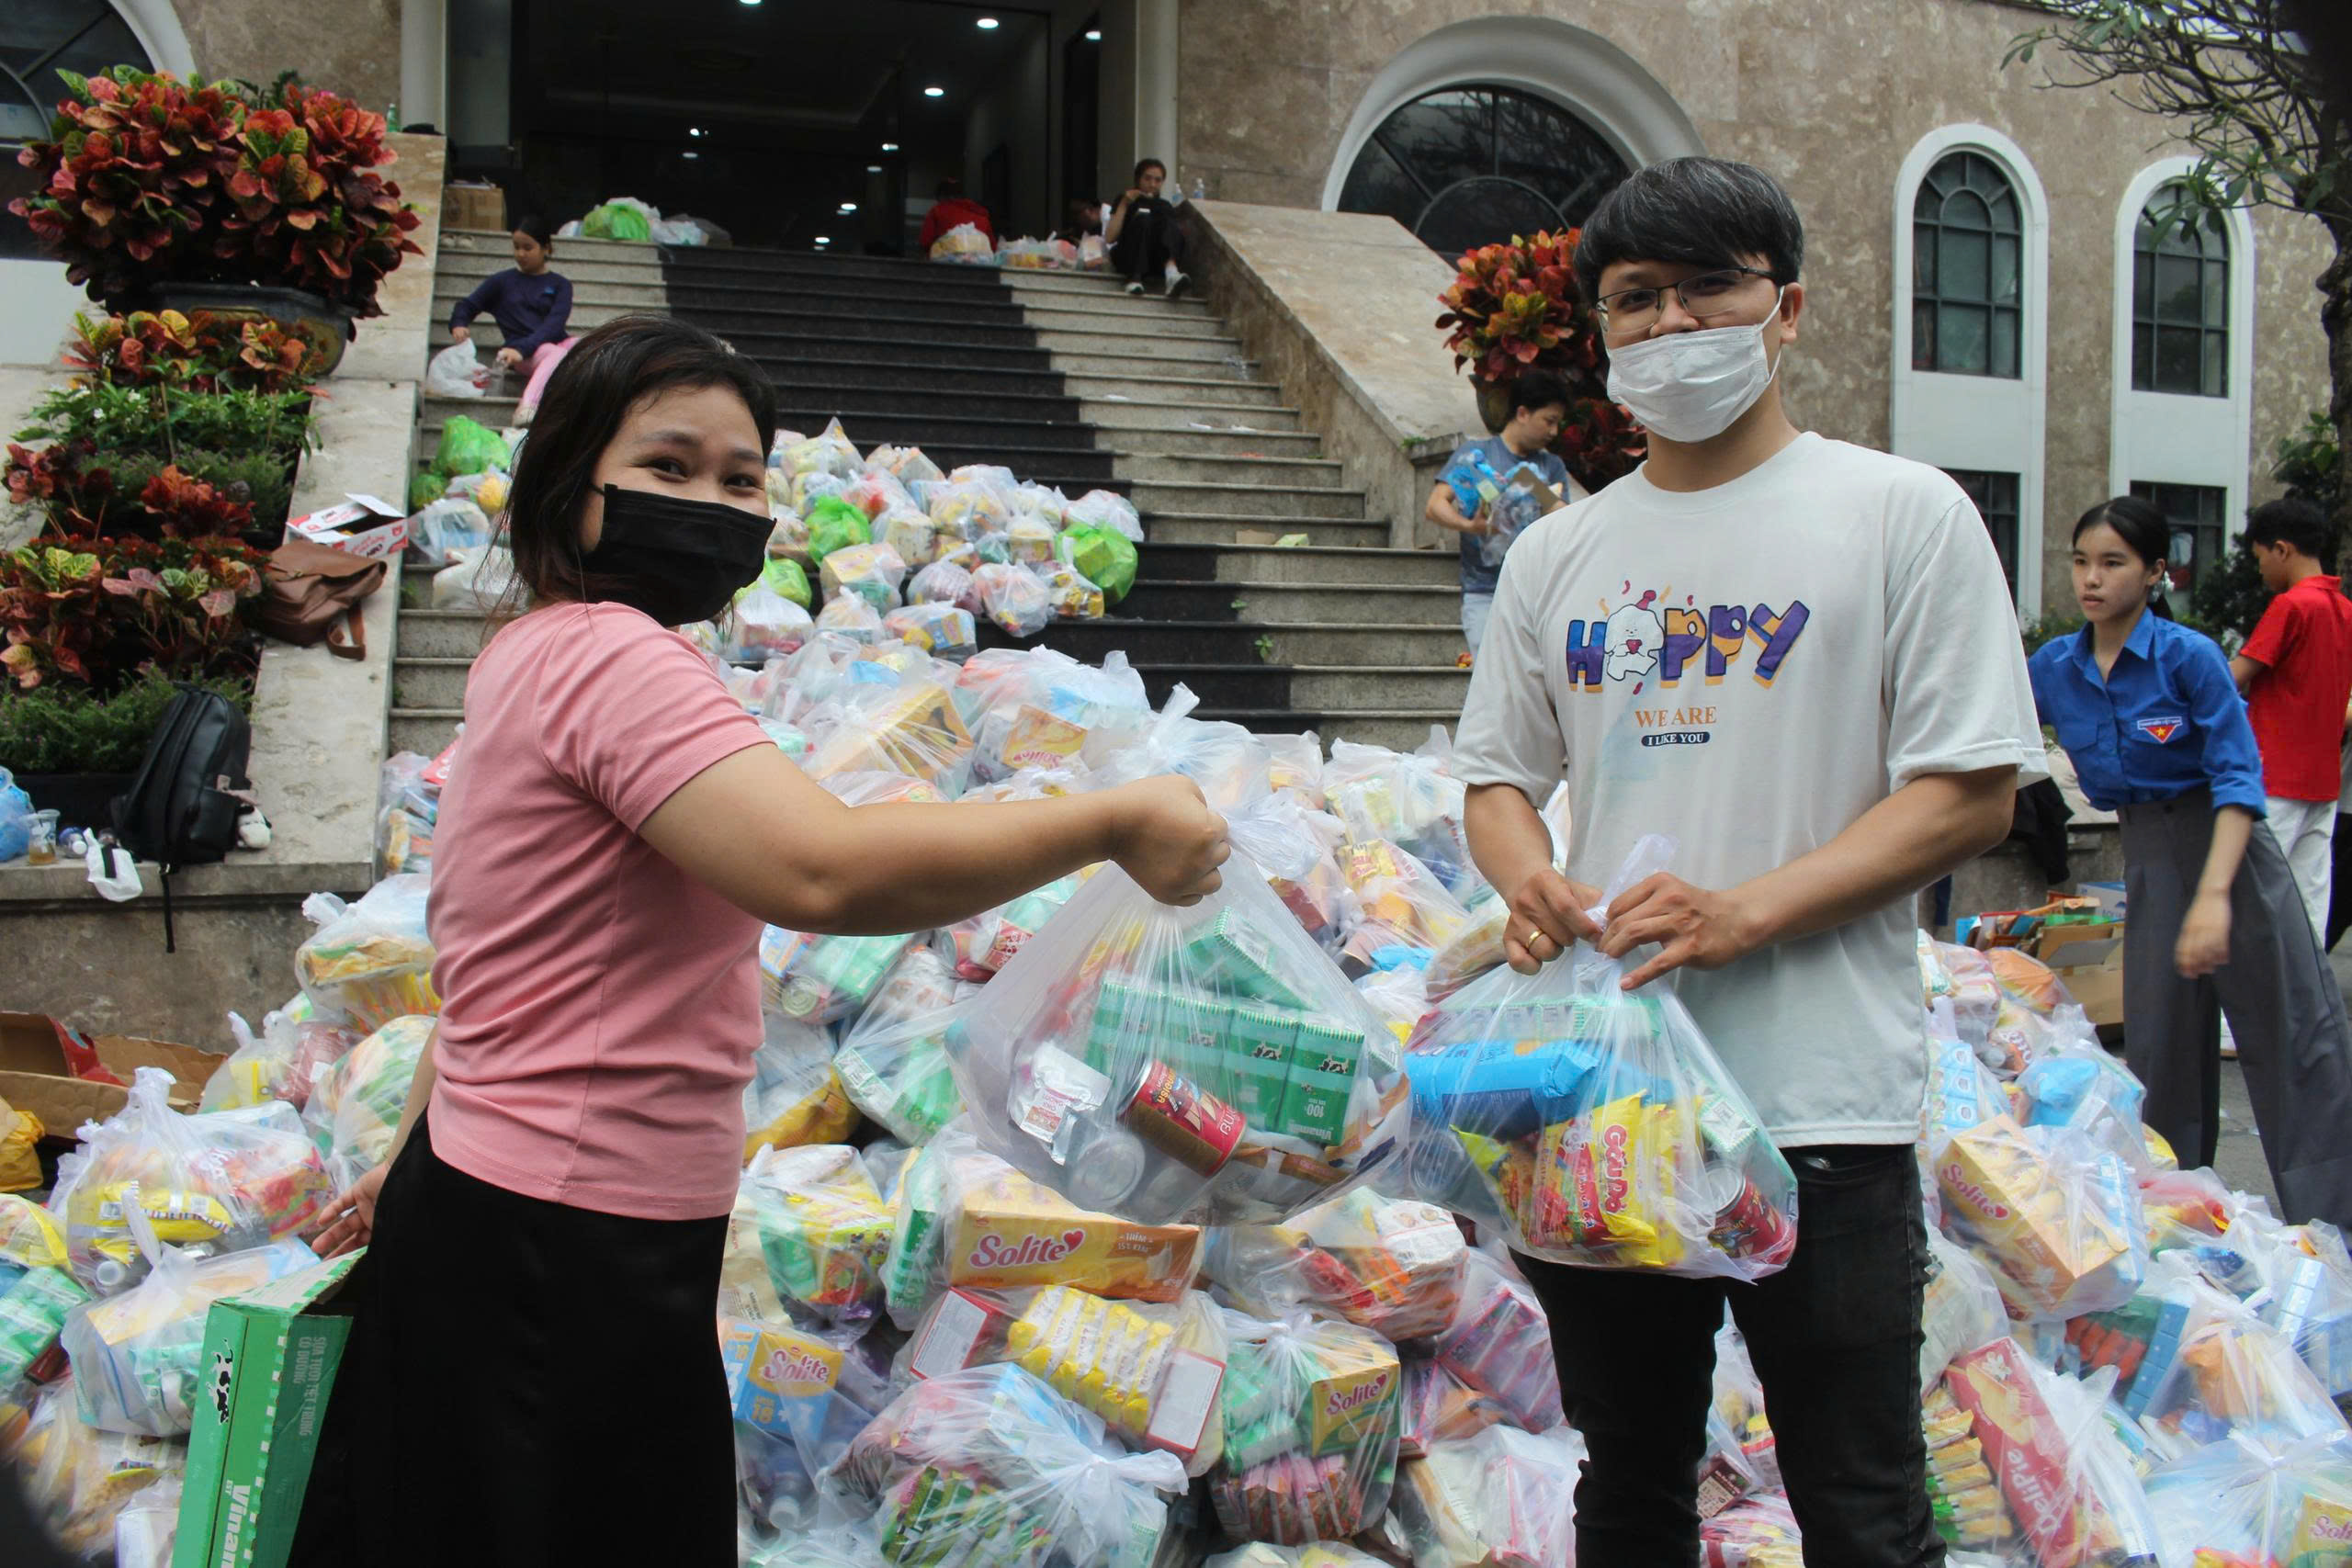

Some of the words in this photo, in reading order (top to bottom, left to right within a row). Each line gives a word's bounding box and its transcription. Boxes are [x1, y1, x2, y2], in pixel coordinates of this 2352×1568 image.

[1634, 708, 1668, 728] WE
[1672, 705, 1717, 725] ARE
[1679, 733, 1704, 743] YOU
[1942, 1164, 1994, 1214] Solite
[970, 1234, 1065, 1269] Solite
[761, 1349, 830, 1382] Solite
[1326, 1384, 1379, 1416] Solite
